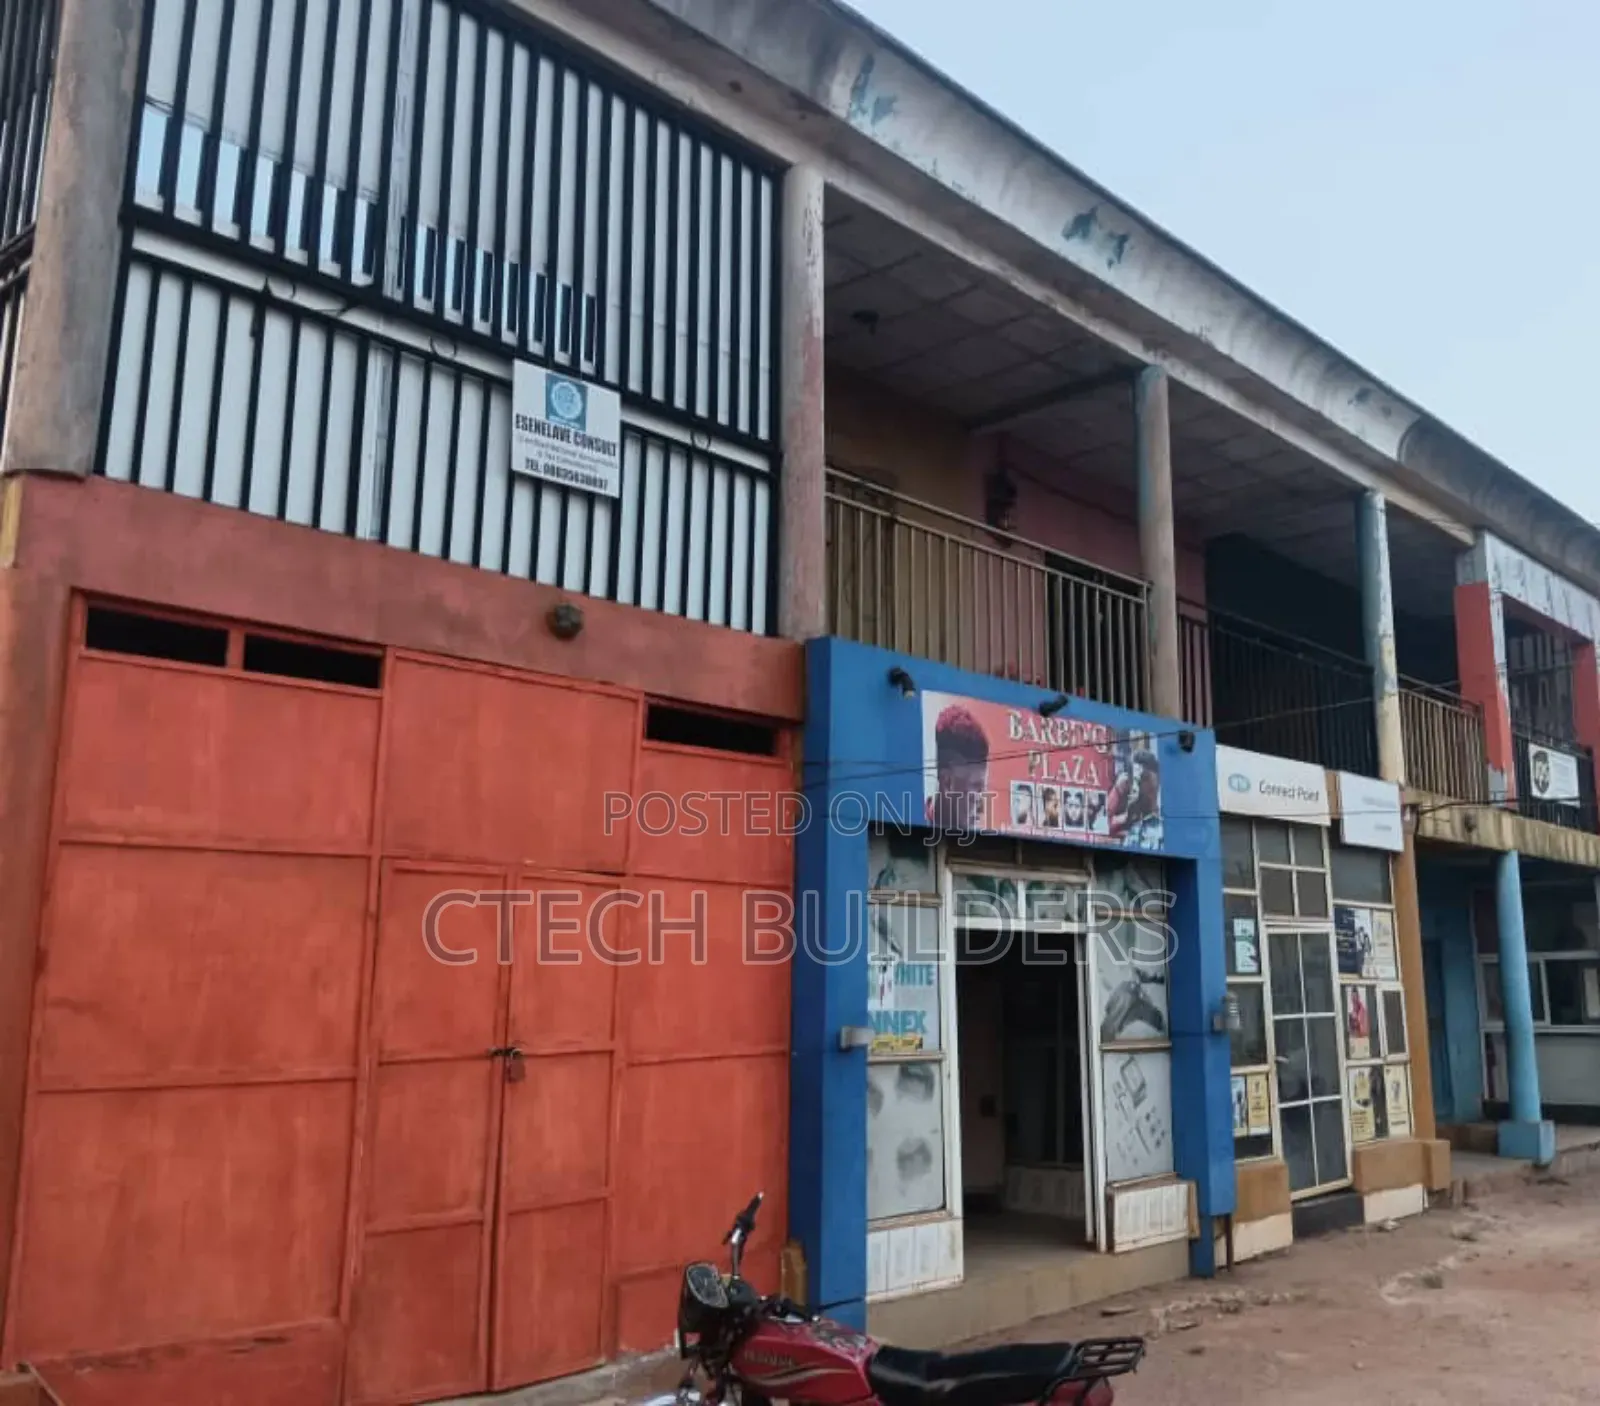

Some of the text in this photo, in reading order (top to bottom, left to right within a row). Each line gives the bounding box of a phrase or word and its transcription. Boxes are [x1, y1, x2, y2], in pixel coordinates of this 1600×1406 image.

[573, 431, 617, 457] CONSULT
[1027, 749, 1101, 786] PLAZA
[1259, 779, 1319, 802] Connect Point
